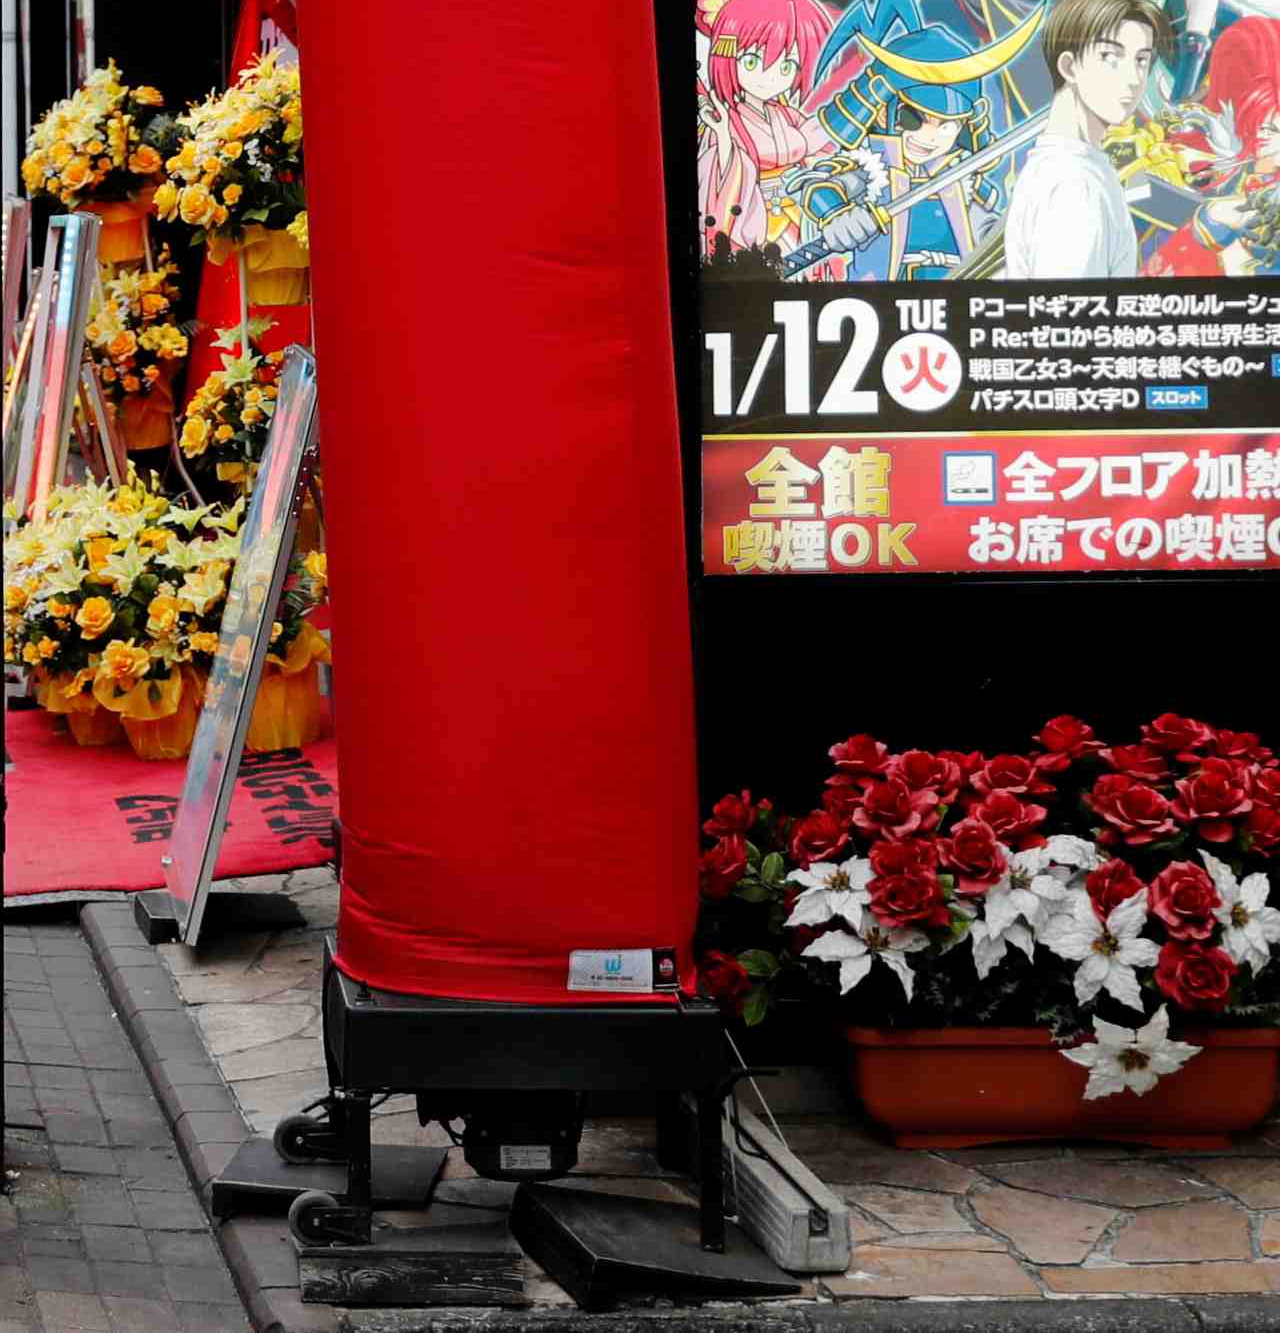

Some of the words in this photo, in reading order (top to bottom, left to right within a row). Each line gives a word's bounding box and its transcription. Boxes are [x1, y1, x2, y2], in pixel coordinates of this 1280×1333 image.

[895, 299, 947, 331] TUE
[969, 295, 1110, 317] Pコードギアス
[705, 297, 880, 416] 1/12
[969, 328, 986, 348] P
[898, 346, 949, 394] 火
[970, 388, 1141, 411] パチスロ頭文字D
[1151, 391, 1202, 405] スロット
[744, 445, 892, 519] 全館
[722, 519, 919, 572] 喫煙OK
